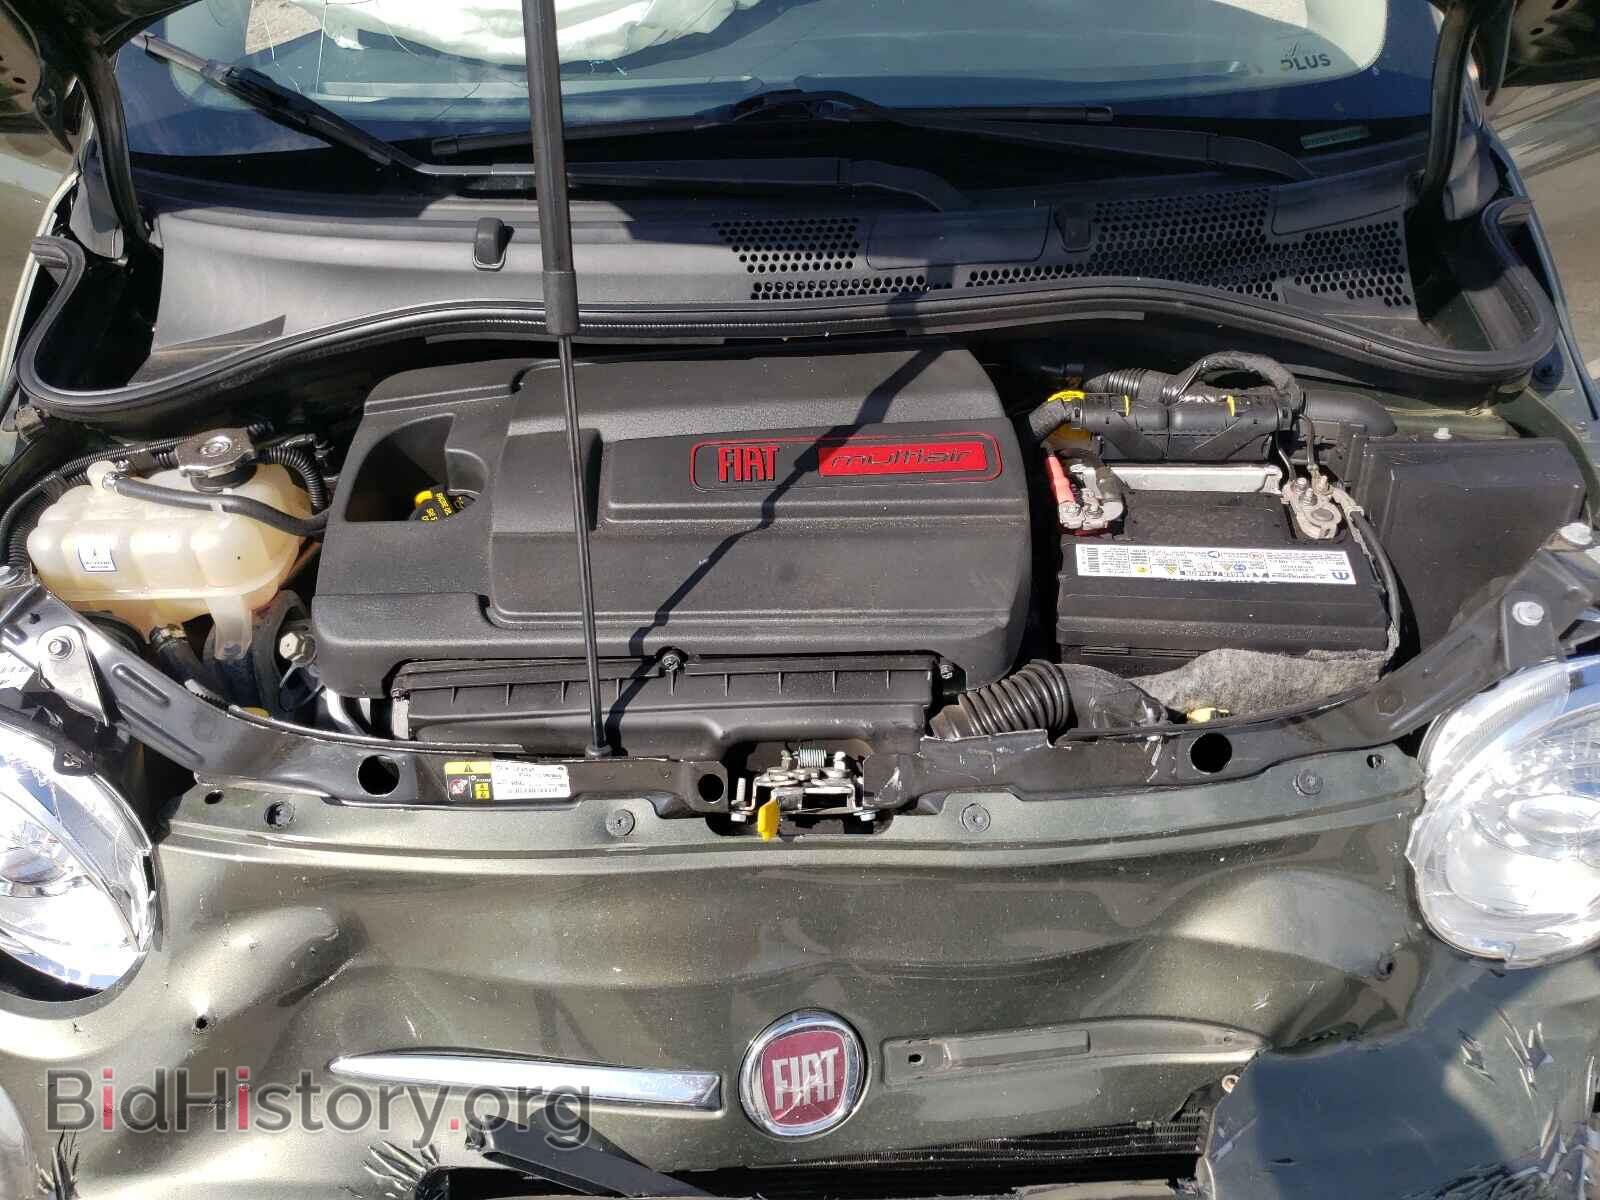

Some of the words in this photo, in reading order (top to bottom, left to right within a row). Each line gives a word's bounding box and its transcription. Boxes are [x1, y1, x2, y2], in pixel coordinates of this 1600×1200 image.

[718, 446, 779, 482] FIAT
[832, 447, 973, 468] multiair
[772, 1047, 839, 1110] FIAT
